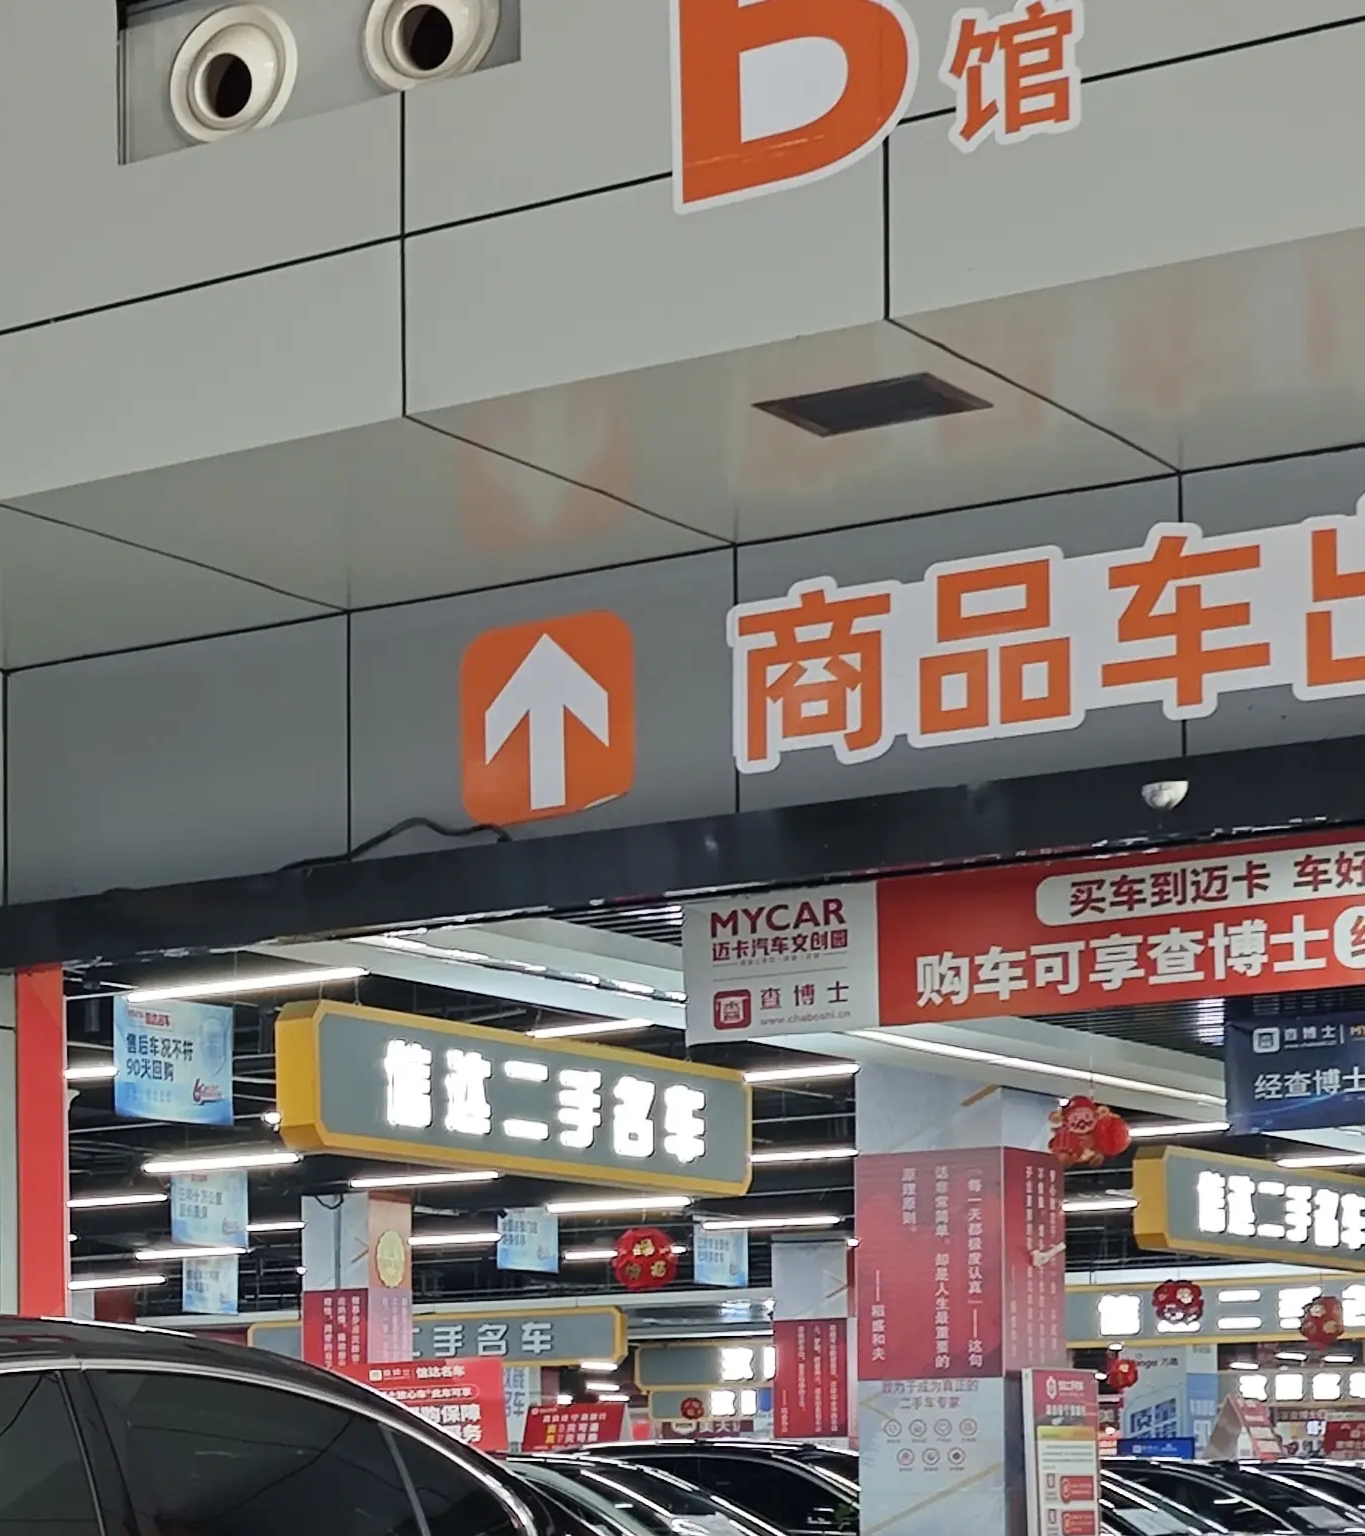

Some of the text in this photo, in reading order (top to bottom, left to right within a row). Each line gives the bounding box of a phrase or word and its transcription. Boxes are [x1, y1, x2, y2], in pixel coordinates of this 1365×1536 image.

[710, 898, 847, 939] MYCAR
[1069, 861, 1270, 918] 买车到迈卡
[916, 914, 1328, 1008] 购车可享查博士
[385, 1038, 707, 1163] 信达二手名车
